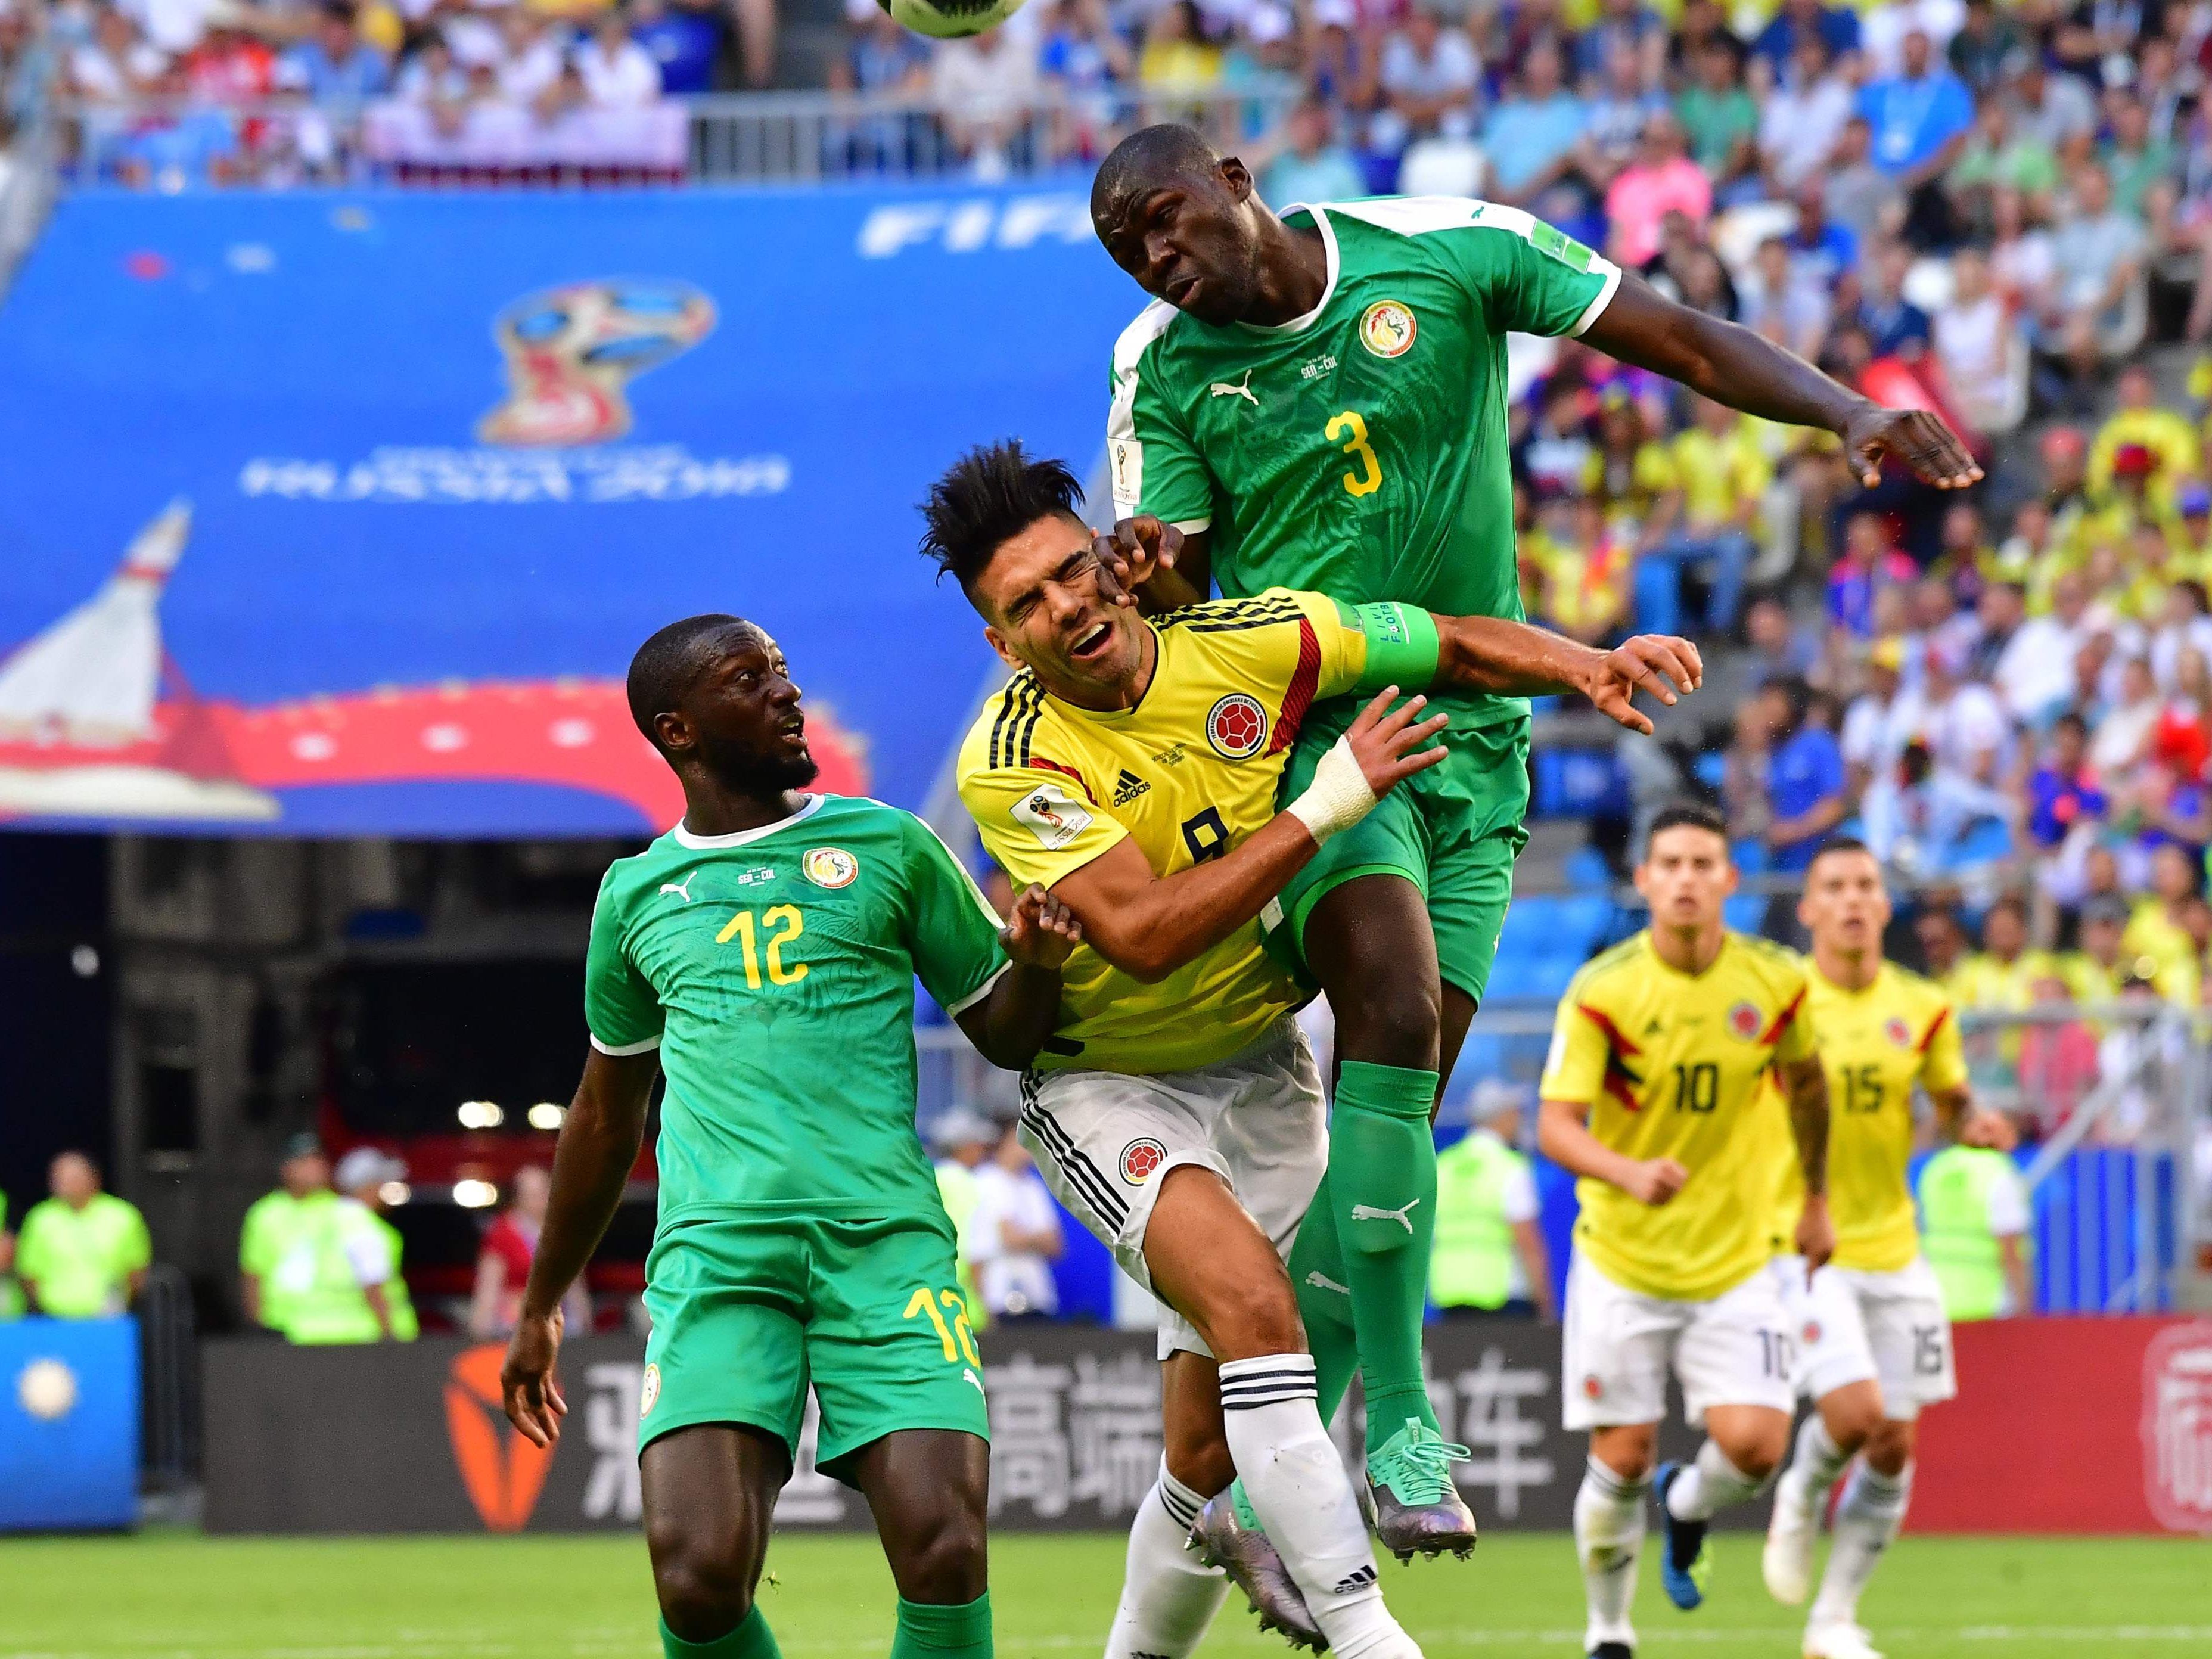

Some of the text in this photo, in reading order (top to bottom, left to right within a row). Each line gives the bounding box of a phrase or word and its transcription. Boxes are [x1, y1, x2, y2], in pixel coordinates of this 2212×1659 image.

[1325, 411, 1382, 497] 3
[1113, 781, 1151, 807] adidas
[716, 904, 808, 989] 12
[1674, 1062, 1719, 1113] 10
[1840, 1063, 1884, 1113] 15
[902, 1287, 981, 1371] 12
